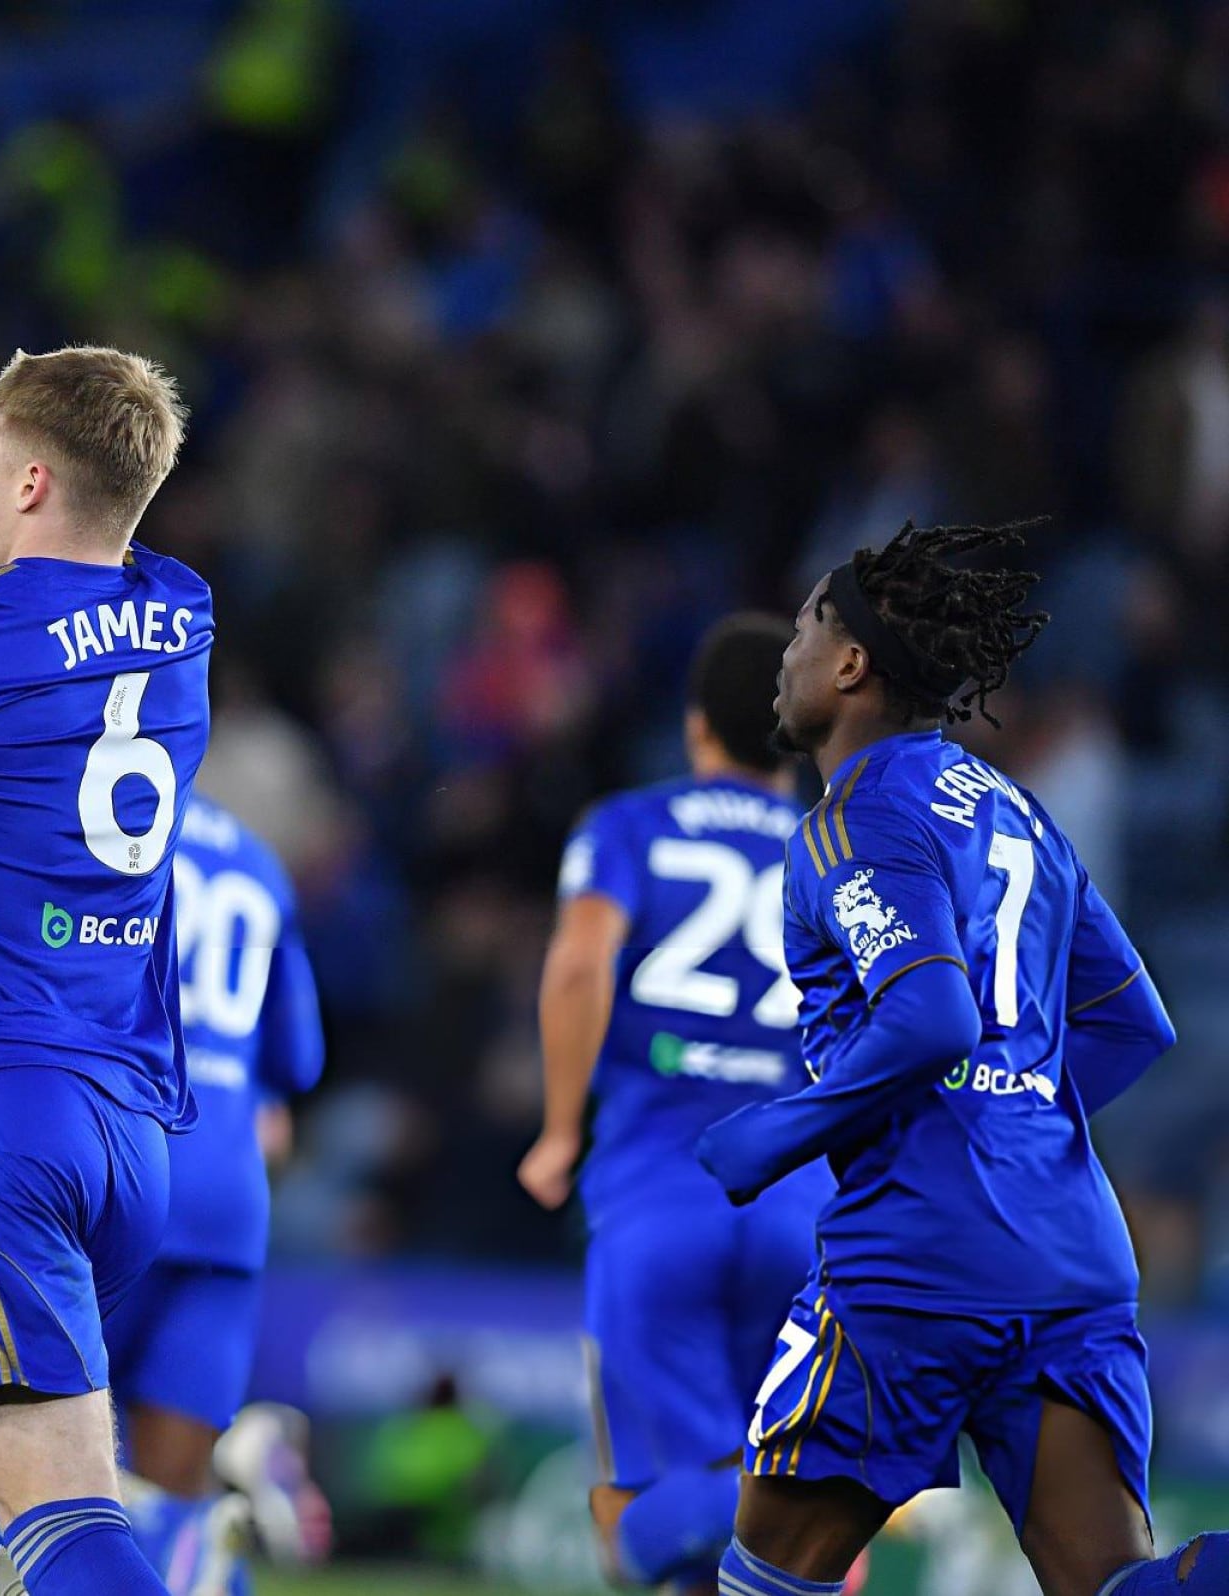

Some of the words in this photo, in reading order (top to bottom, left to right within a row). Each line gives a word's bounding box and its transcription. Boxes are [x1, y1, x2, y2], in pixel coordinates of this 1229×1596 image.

[47, 600, 193, 671] JAMES
[78, 672, 177, 876] 6
[988, 831, 1035, 1028] 7
[748, 1317, 817, 1447] 7
